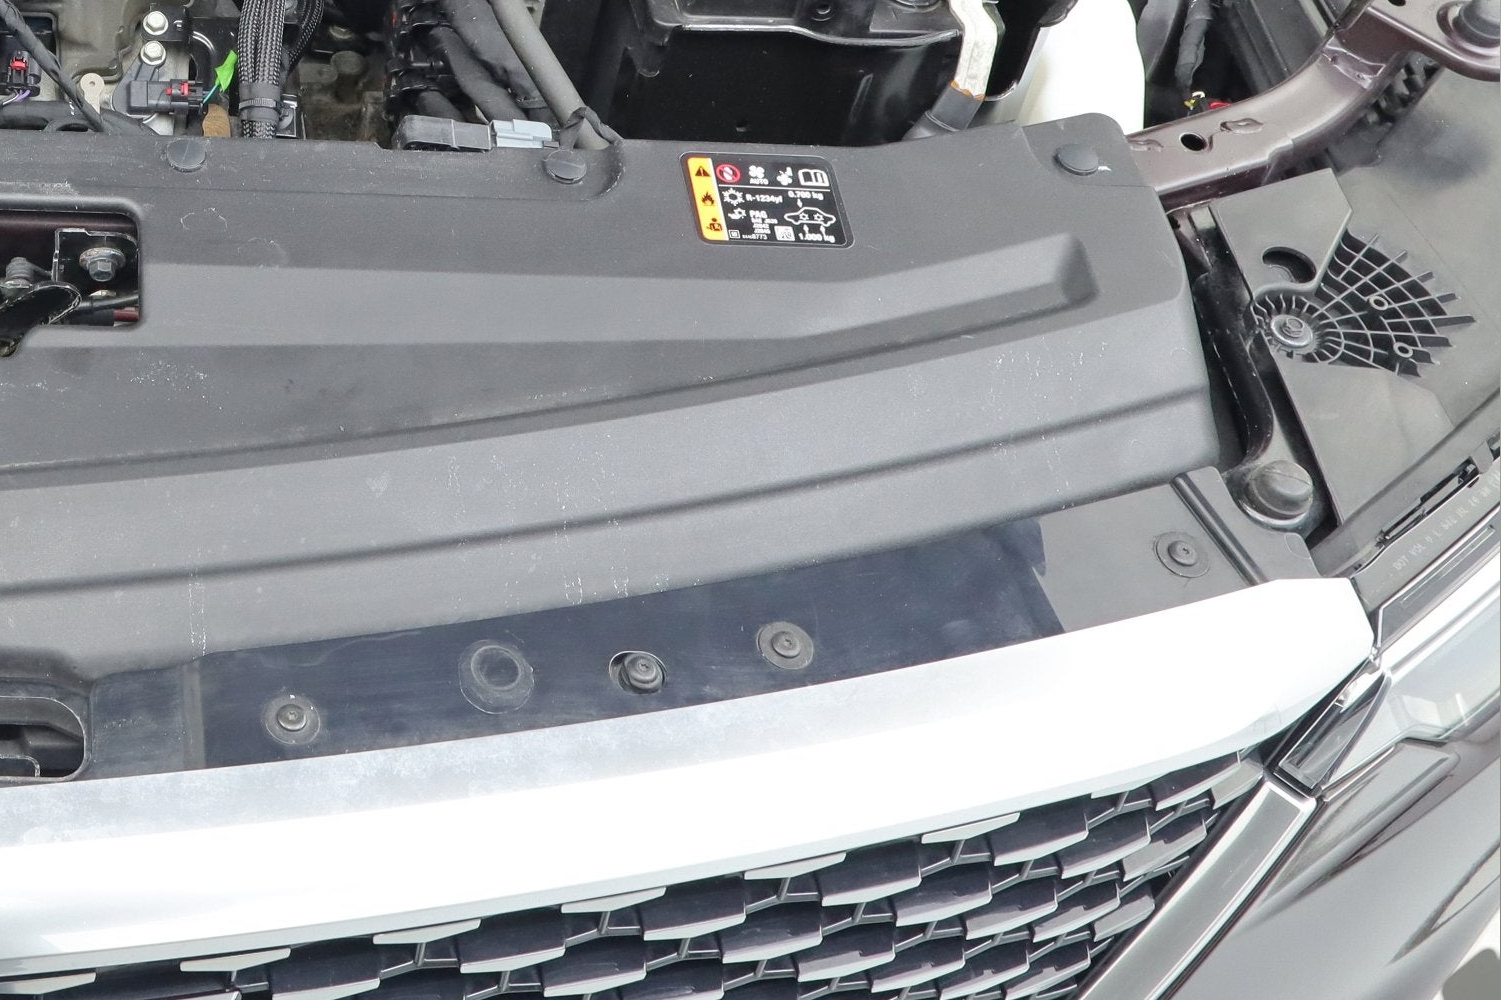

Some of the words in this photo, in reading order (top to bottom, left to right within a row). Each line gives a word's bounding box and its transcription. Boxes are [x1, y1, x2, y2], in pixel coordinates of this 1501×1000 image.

[787, 190, 811, 199] 0.700
[812, 191, 824, 201] kg
[749, 210, 768, 219] PAG
[823, 233, 836, 243] kg
